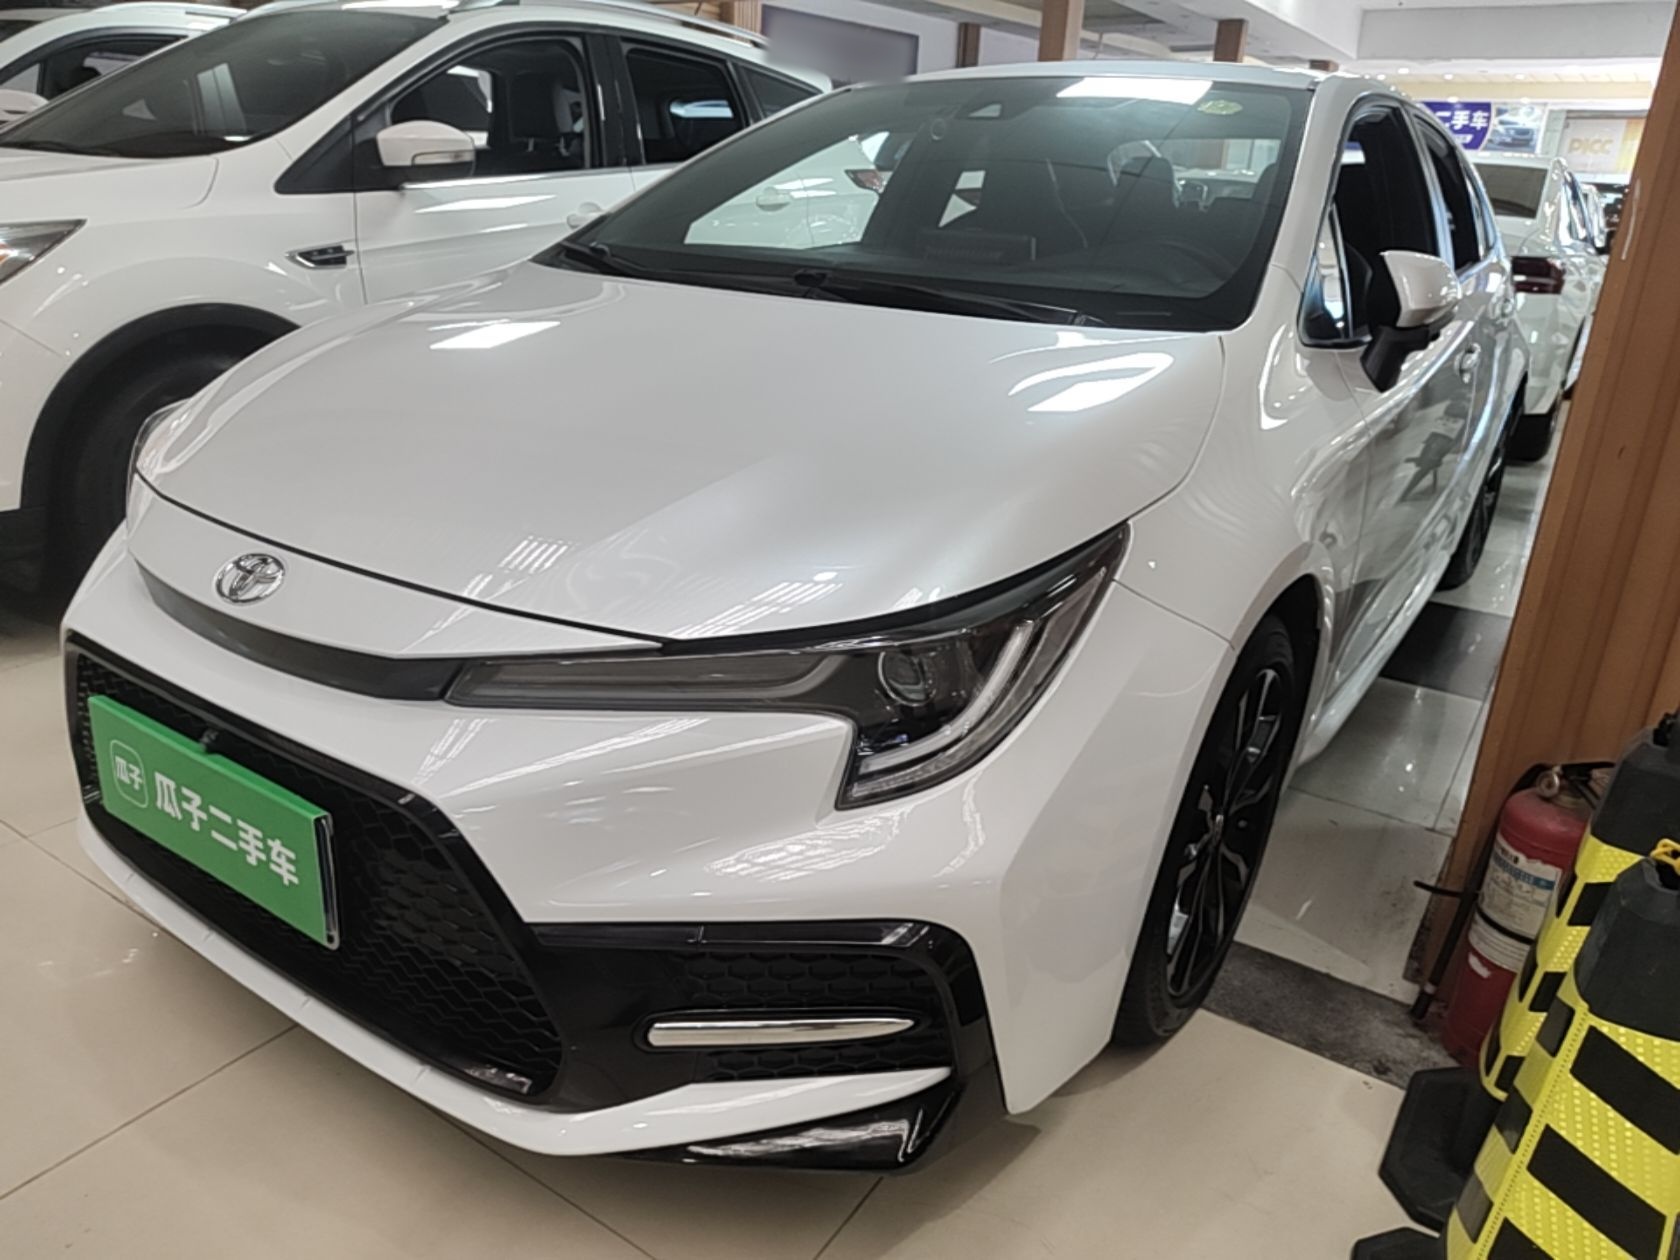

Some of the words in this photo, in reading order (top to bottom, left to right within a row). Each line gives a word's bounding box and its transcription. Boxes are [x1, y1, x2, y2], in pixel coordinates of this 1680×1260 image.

[114, 755, 143, 790] 瓜子
[154, 771, 299, 887] 瓜子二手车
